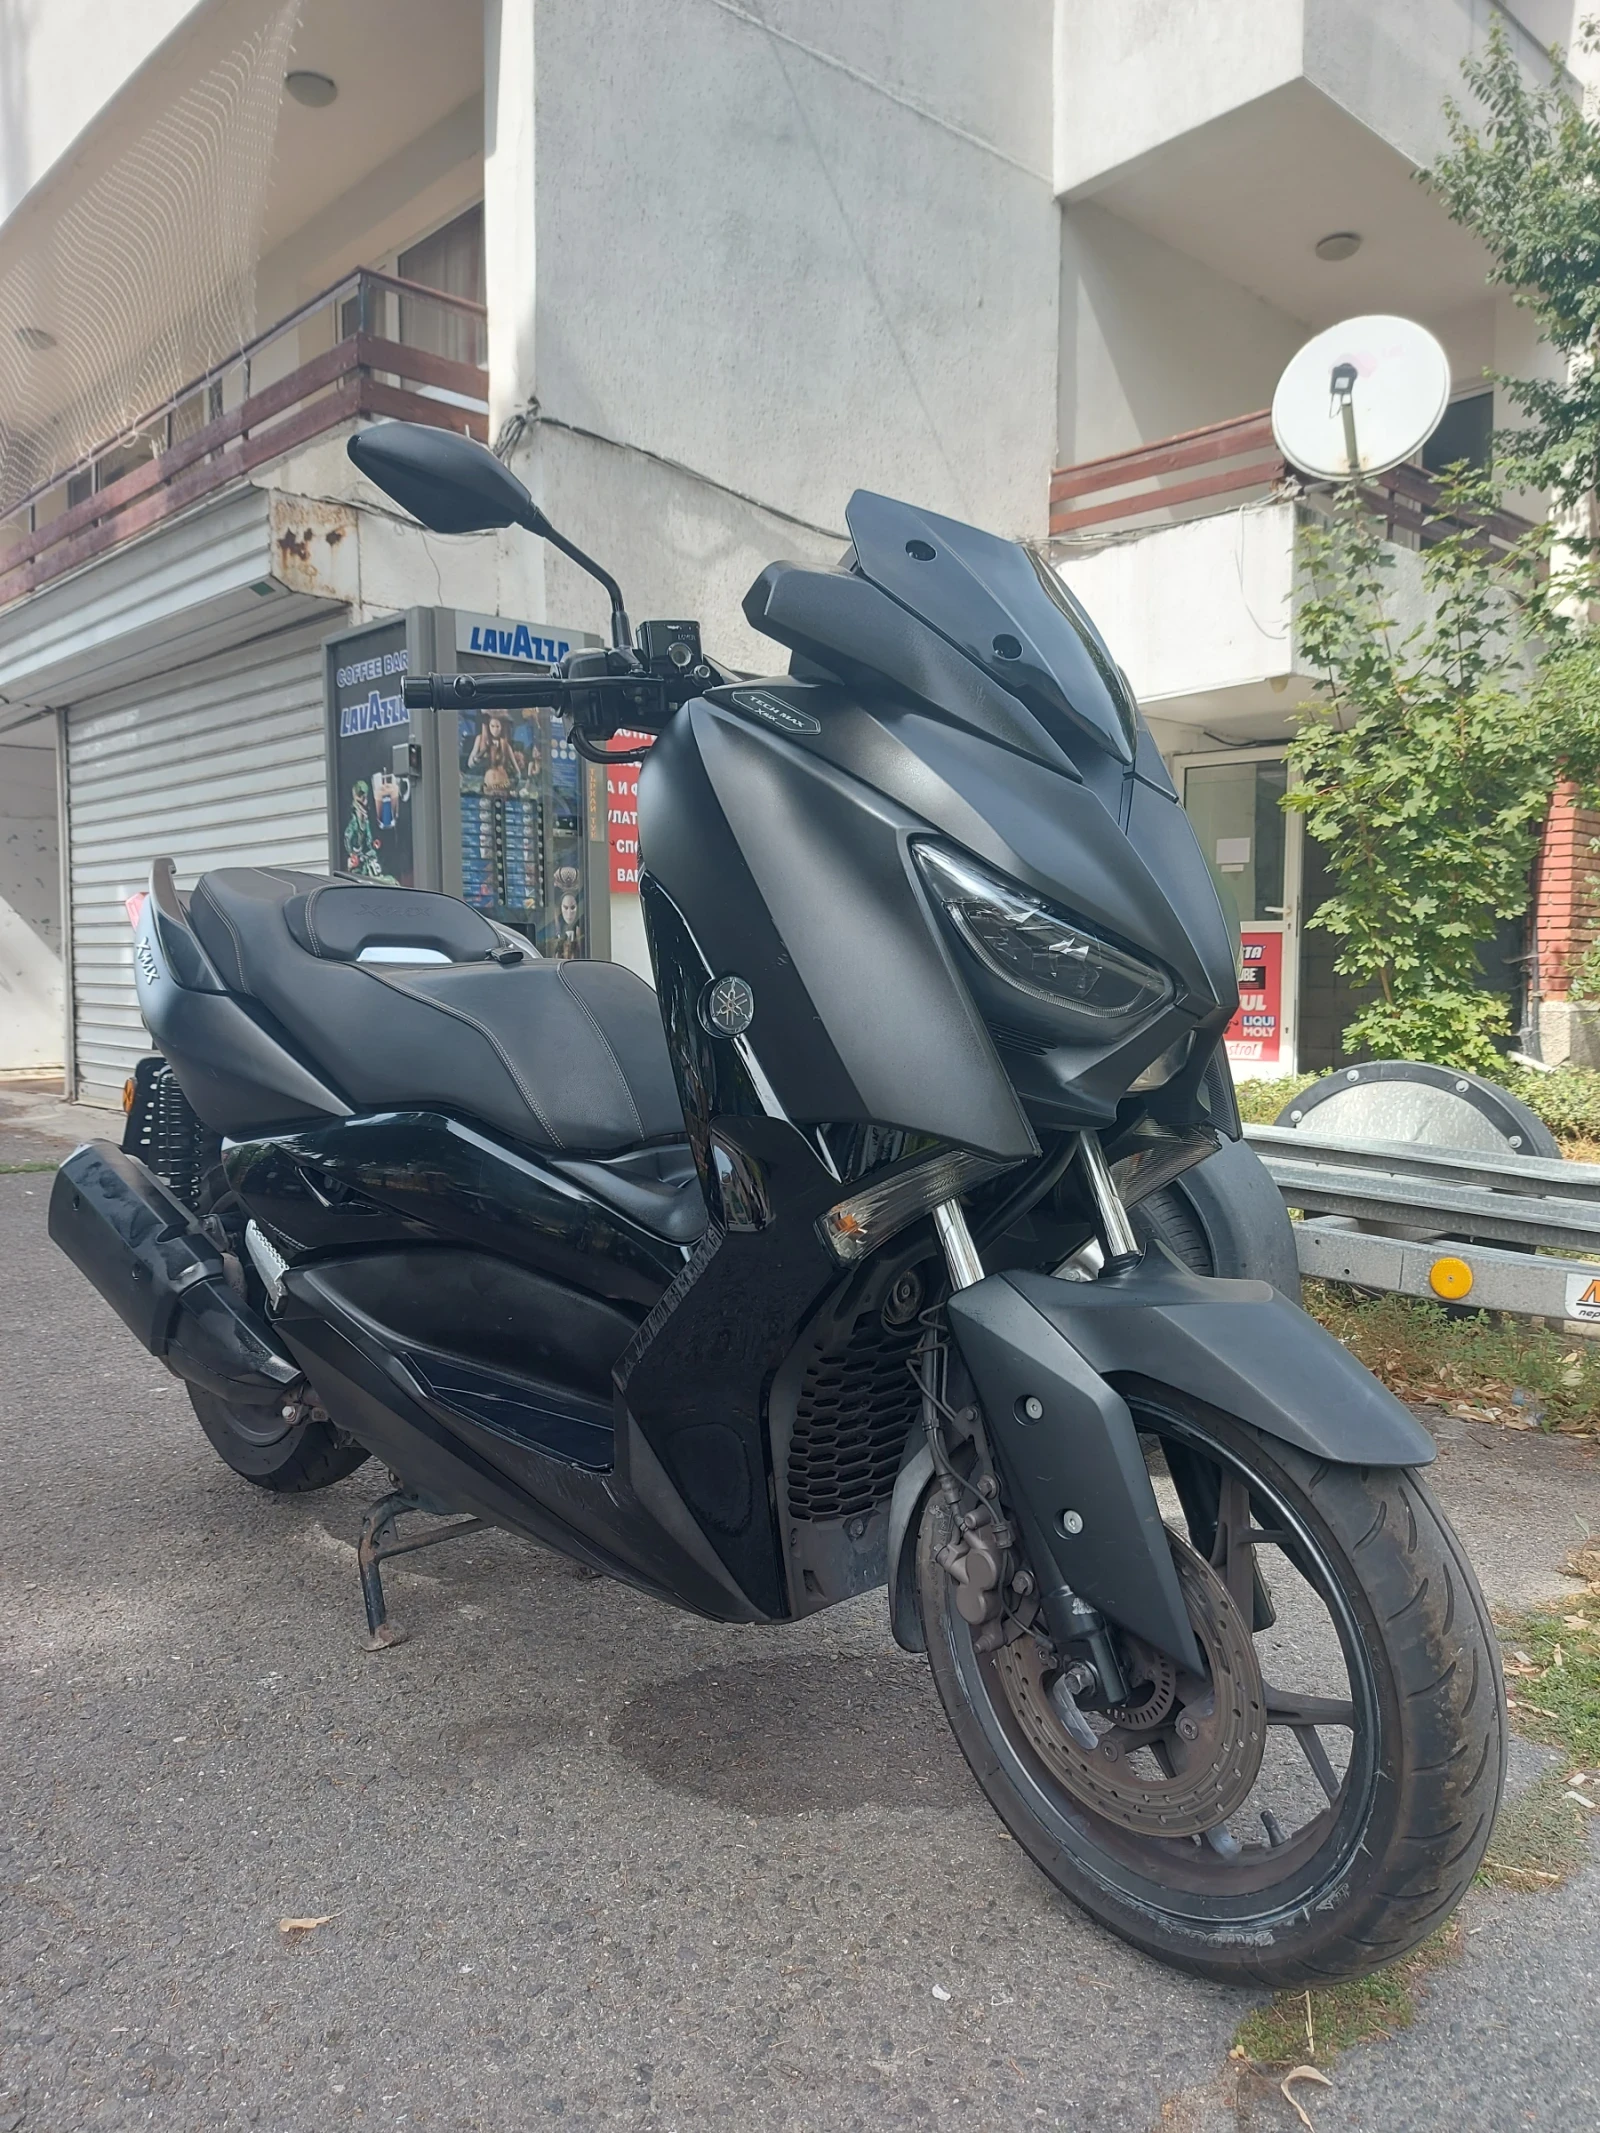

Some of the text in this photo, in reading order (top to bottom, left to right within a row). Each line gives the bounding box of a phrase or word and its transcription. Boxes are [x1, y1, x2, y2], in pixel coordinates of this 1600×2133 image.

[336, 649, 409, 688] COFFEE BAR
[340, 690, 410, 738] LAVAZZA
[750, 695, 805, 729] TECH MAX
[618, 780, 628, 796] И
[1239, 994, 1267, 1012] UL
[1243, 1015, 1275, 1027] LIQUI
[1242, 1026, 1276, 1038] MOLY
